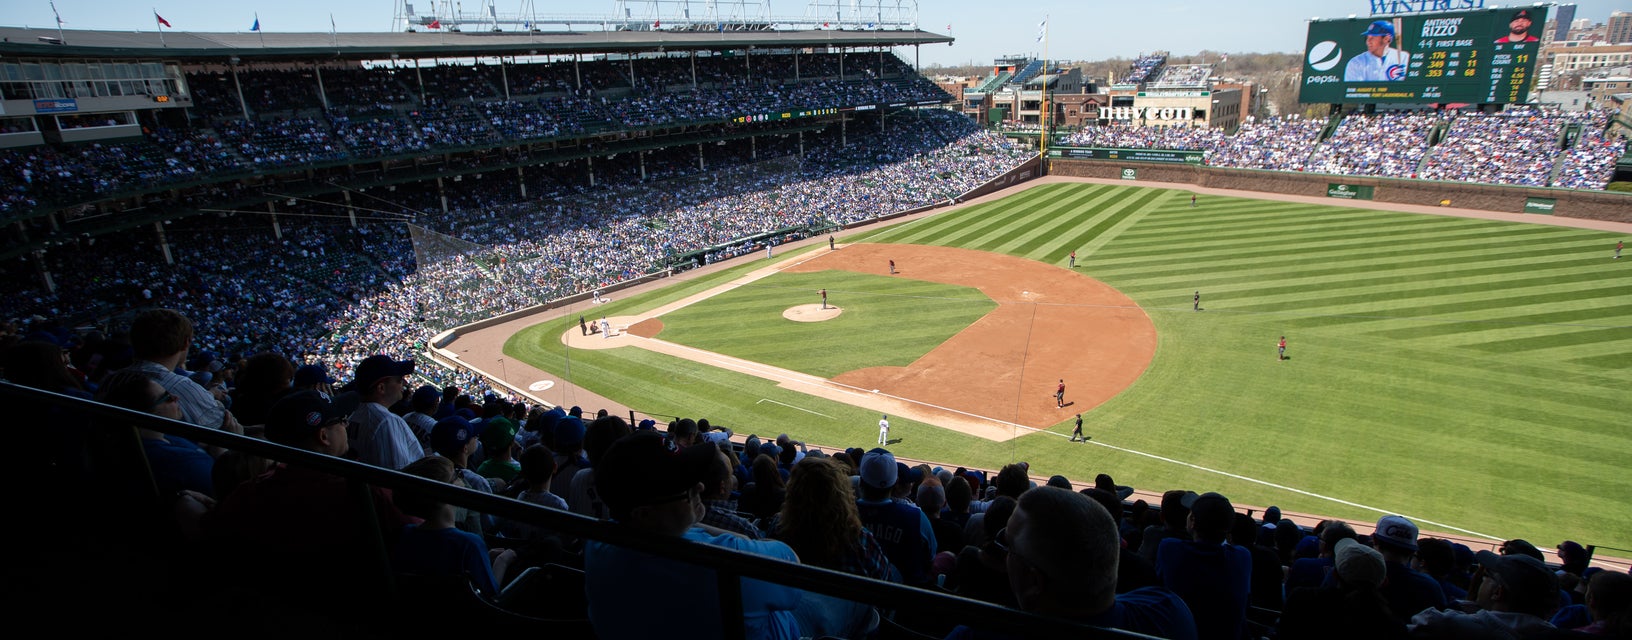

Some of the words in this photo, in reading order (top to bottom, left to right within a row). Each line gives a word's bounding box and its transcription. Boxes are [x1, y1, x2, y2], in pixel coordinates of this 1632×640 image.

[1370, 0, 1485, 14] WINTRUST
[1423, 17, 1464, 26] ANTHONY
[1421, 25, 1458, 37] RIZZO
[1418, 39, 1433, 48] 44
[1455, 39, 1474, 47] BASE
[1470, 50, 1477, 58] 3
[1516, 54, 1528, 63] 11
[1467, 59, 1477, 67] 11
[1306, 75, 1336, 85] pepsi
[1098, 106, 1193, 120] nuveen
